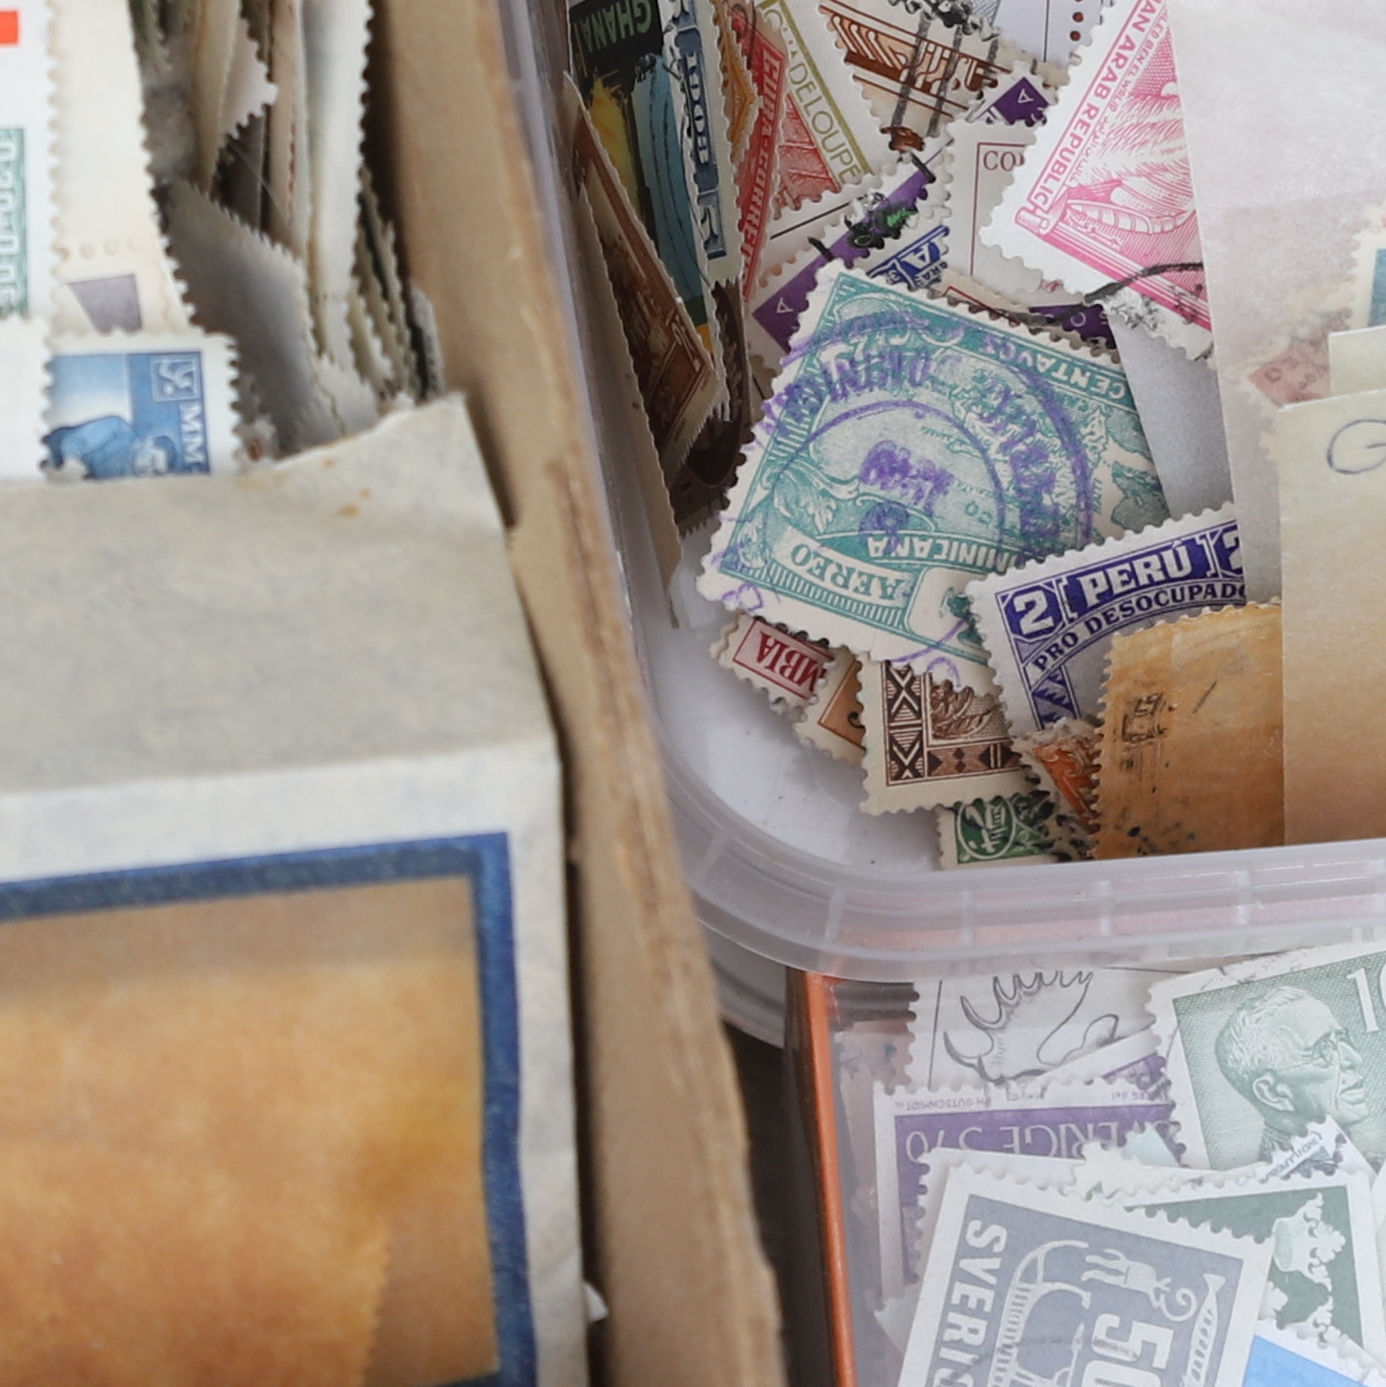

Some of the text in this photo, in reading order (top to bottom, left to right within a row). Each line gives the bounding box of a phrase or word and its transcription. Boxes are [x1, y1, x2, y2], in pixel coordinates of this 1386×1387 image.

[1105, 36, 1141, 95] ARAB
[1026, 100, 1101, 209] REPUBLIC
[1074, 541, 1195, 608] PERÚ
[1032, 634, 1078, 674] PRO
